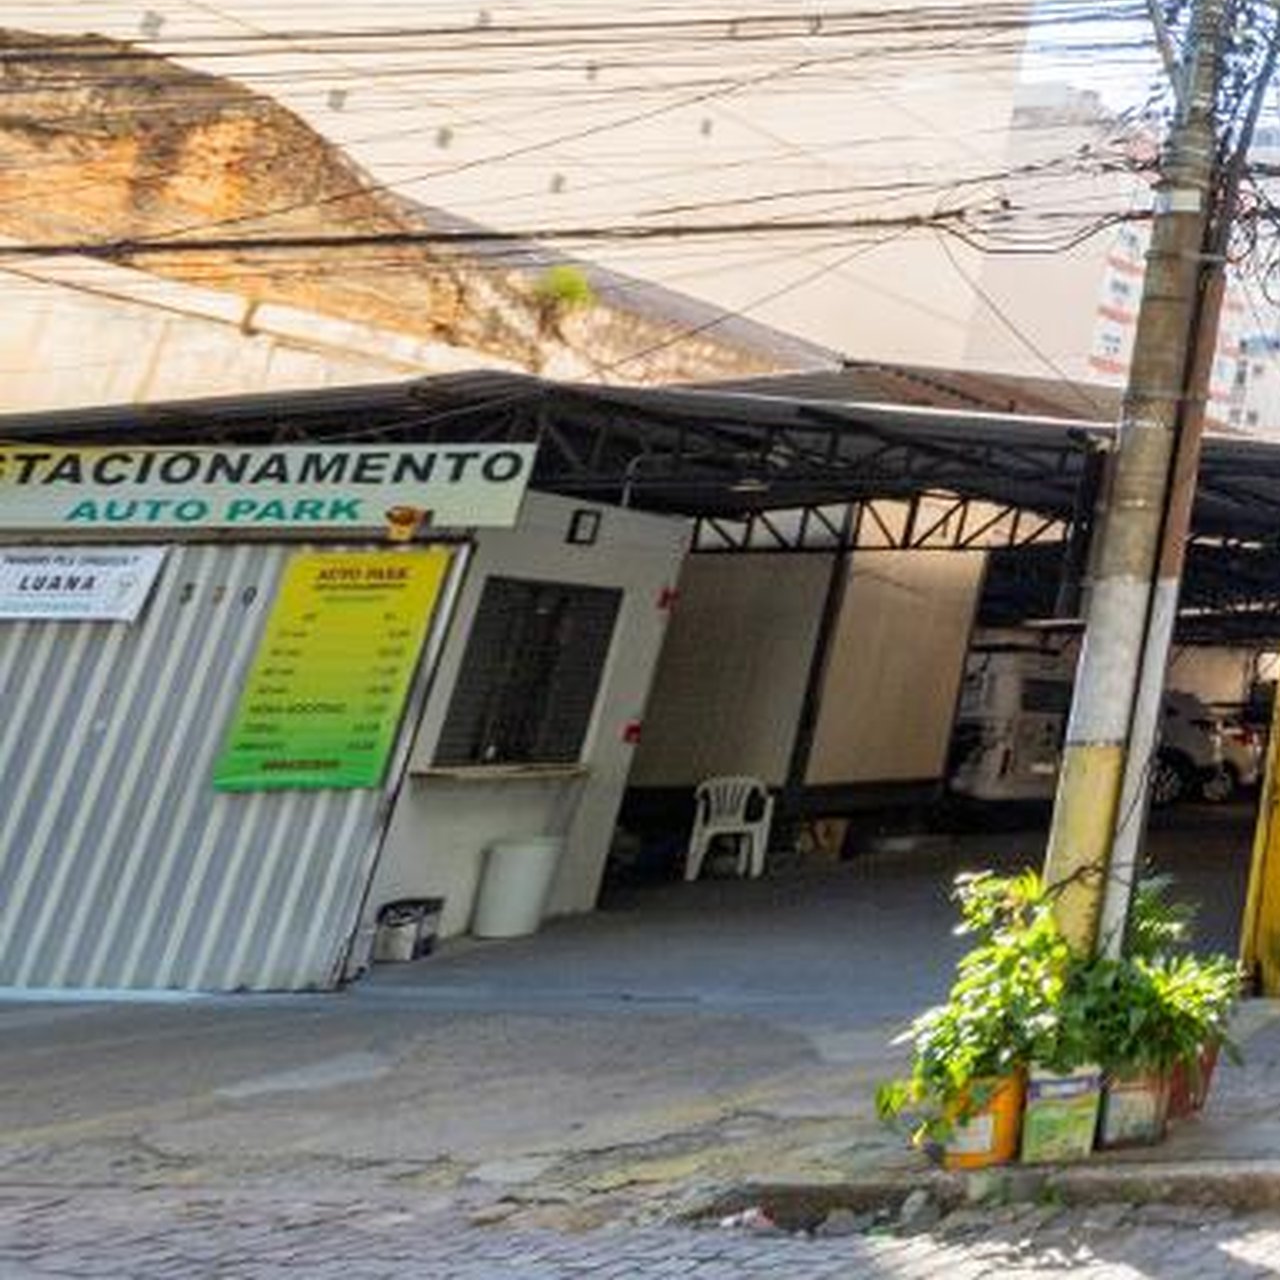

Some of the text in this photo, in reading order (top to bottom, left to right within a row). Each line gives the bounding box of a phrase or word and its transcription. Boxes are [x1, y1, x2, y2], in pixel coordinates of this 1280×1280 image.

[0, 451, 523, 485] TACIONAMENTO
[65, 497, 361, 521] AUTO PARK
[18, 574, 98, 591] LUANA
